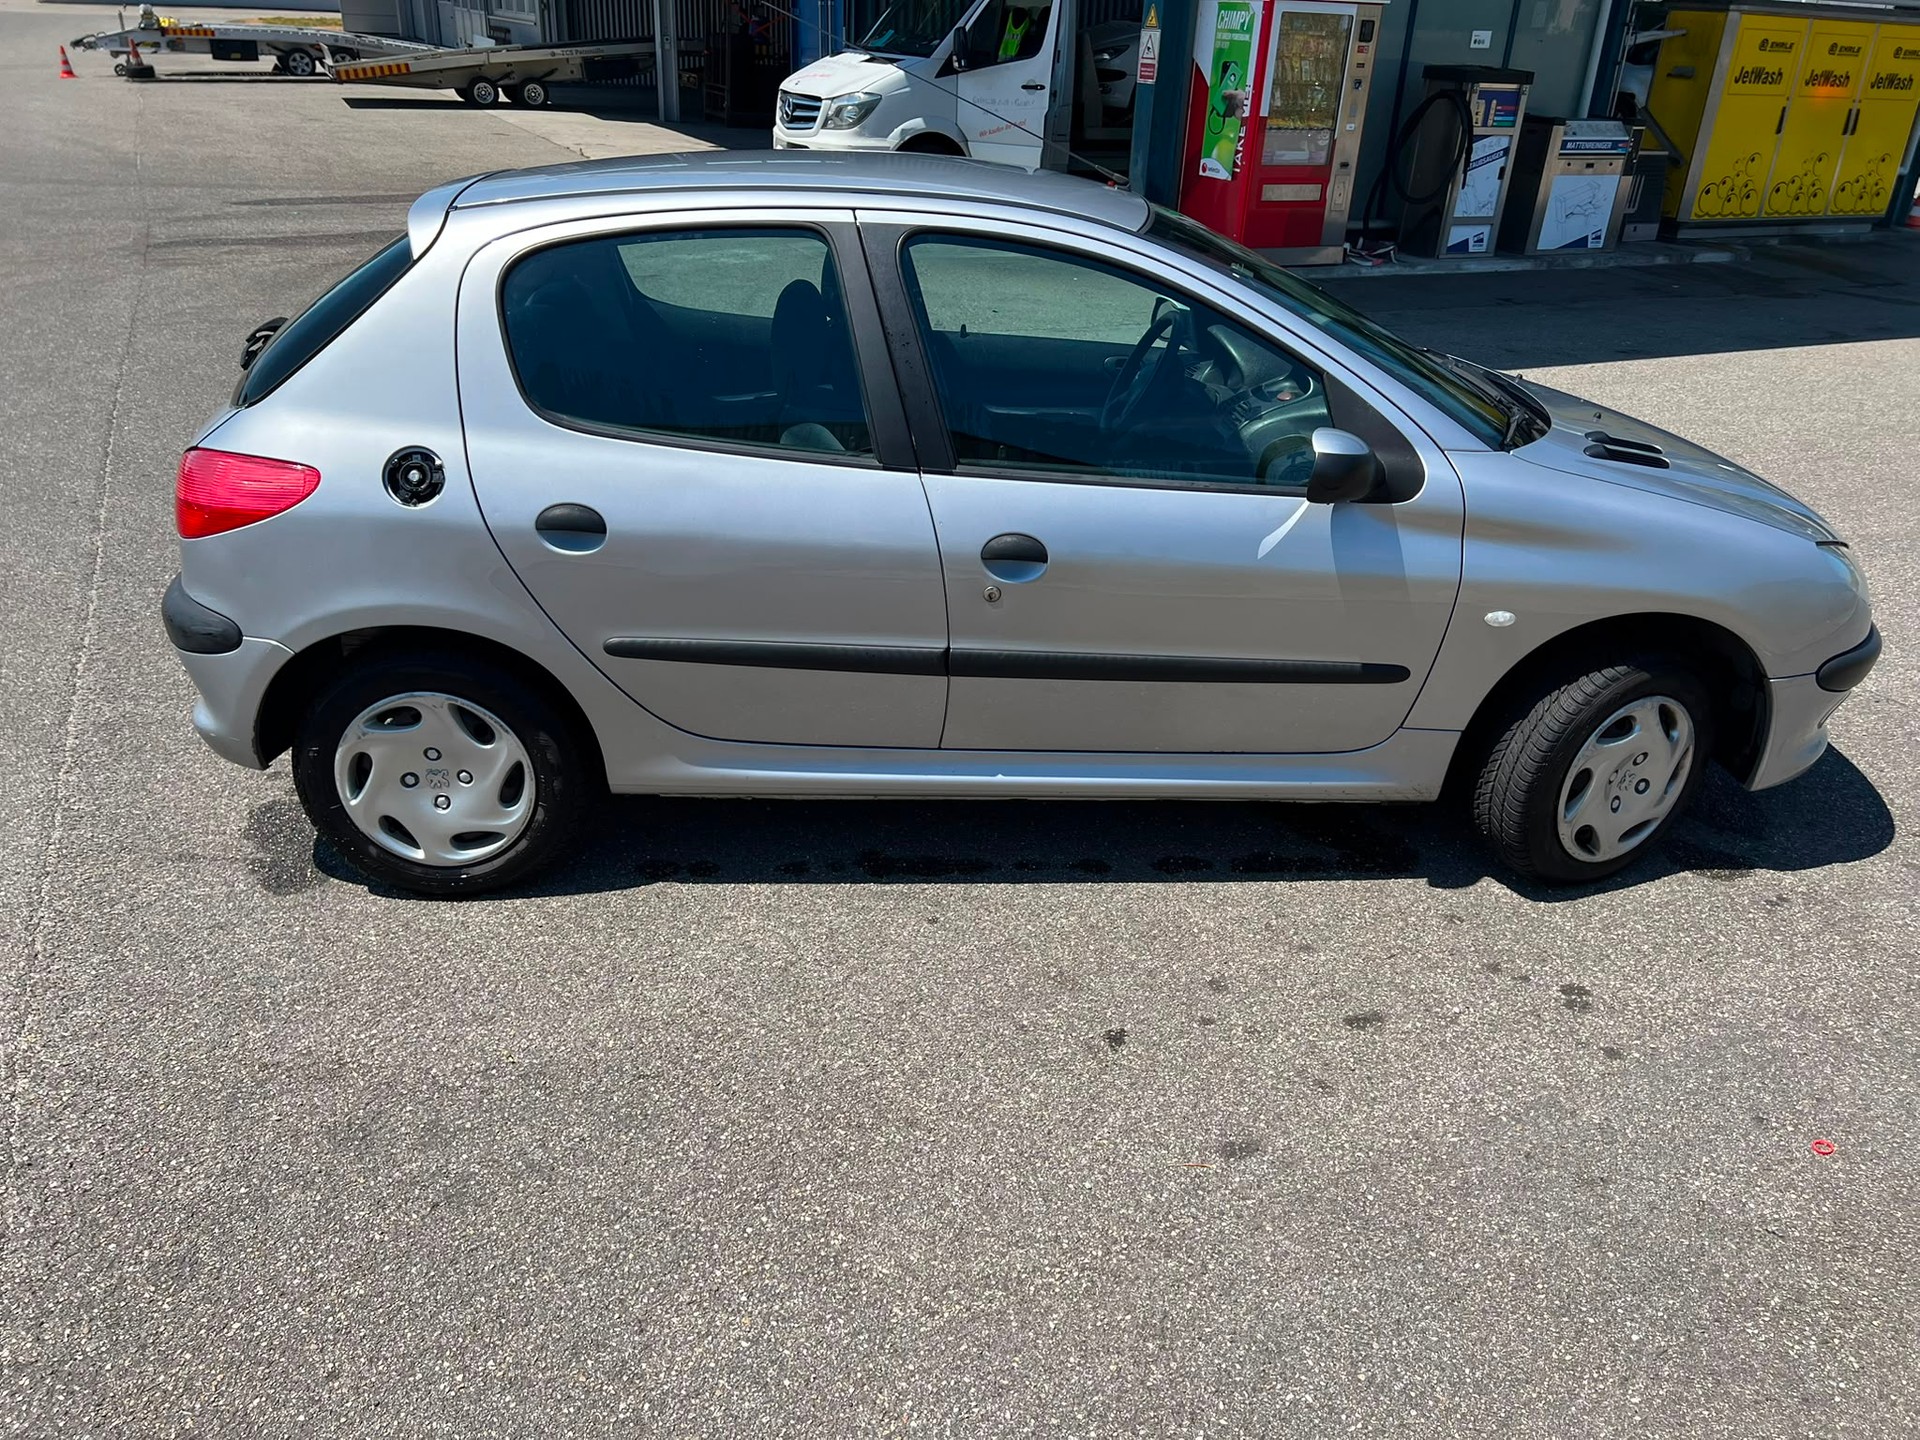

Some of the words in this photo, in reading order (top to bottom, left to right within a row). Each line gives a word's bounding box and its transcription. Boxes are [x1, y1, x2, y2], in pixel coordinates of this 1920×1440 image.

[1217, 10, 1252, 30] CHIMPY
[1734, 66, 1783, 85] JetWash
[1805, 69, 1850, 88] JetWash
[1870, 72, 1914, 90] JetWash
